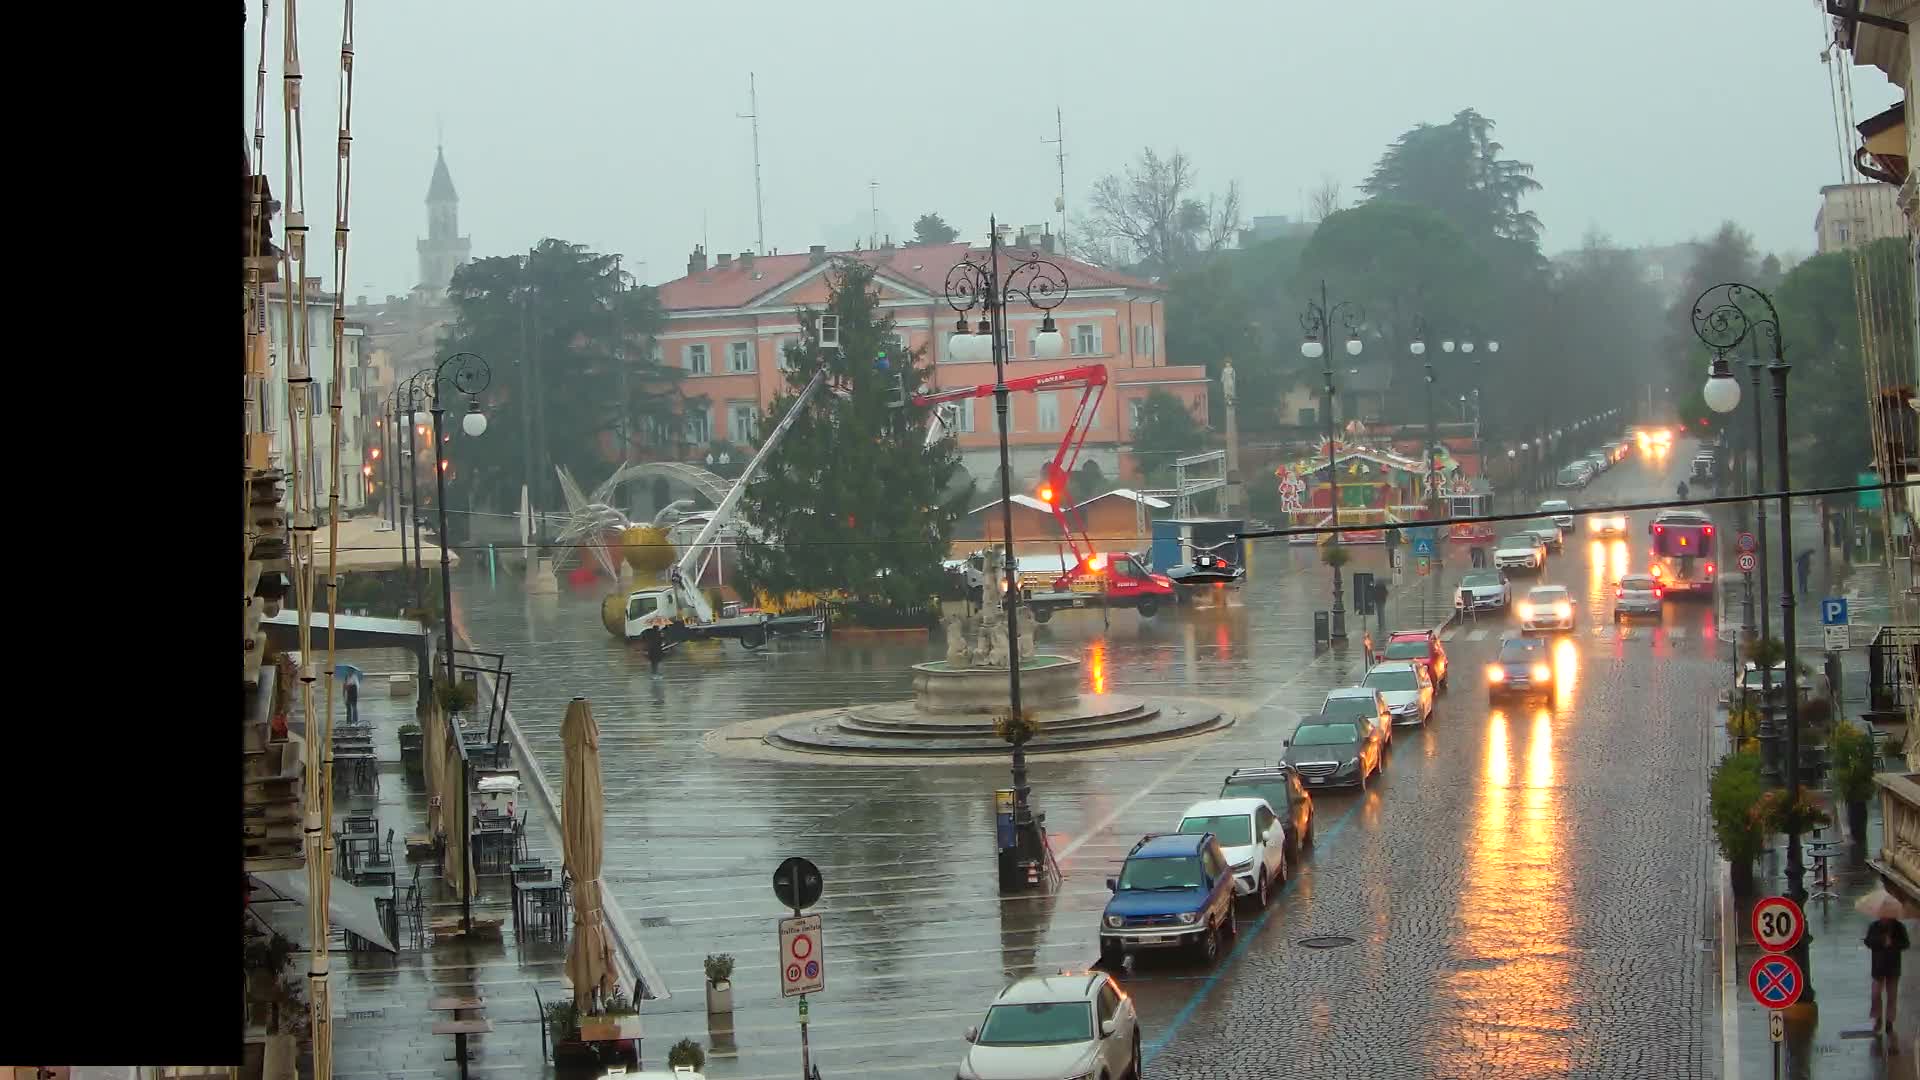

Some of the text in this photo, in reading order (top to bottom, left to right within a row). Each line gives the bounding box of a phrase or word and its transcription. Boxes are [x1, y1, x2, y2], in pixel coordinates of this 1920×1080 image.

[1742, 557, 1752, 566] 20
[1828, 603, 1841, 621] P
[1762, 911, 1791, 938] 30
